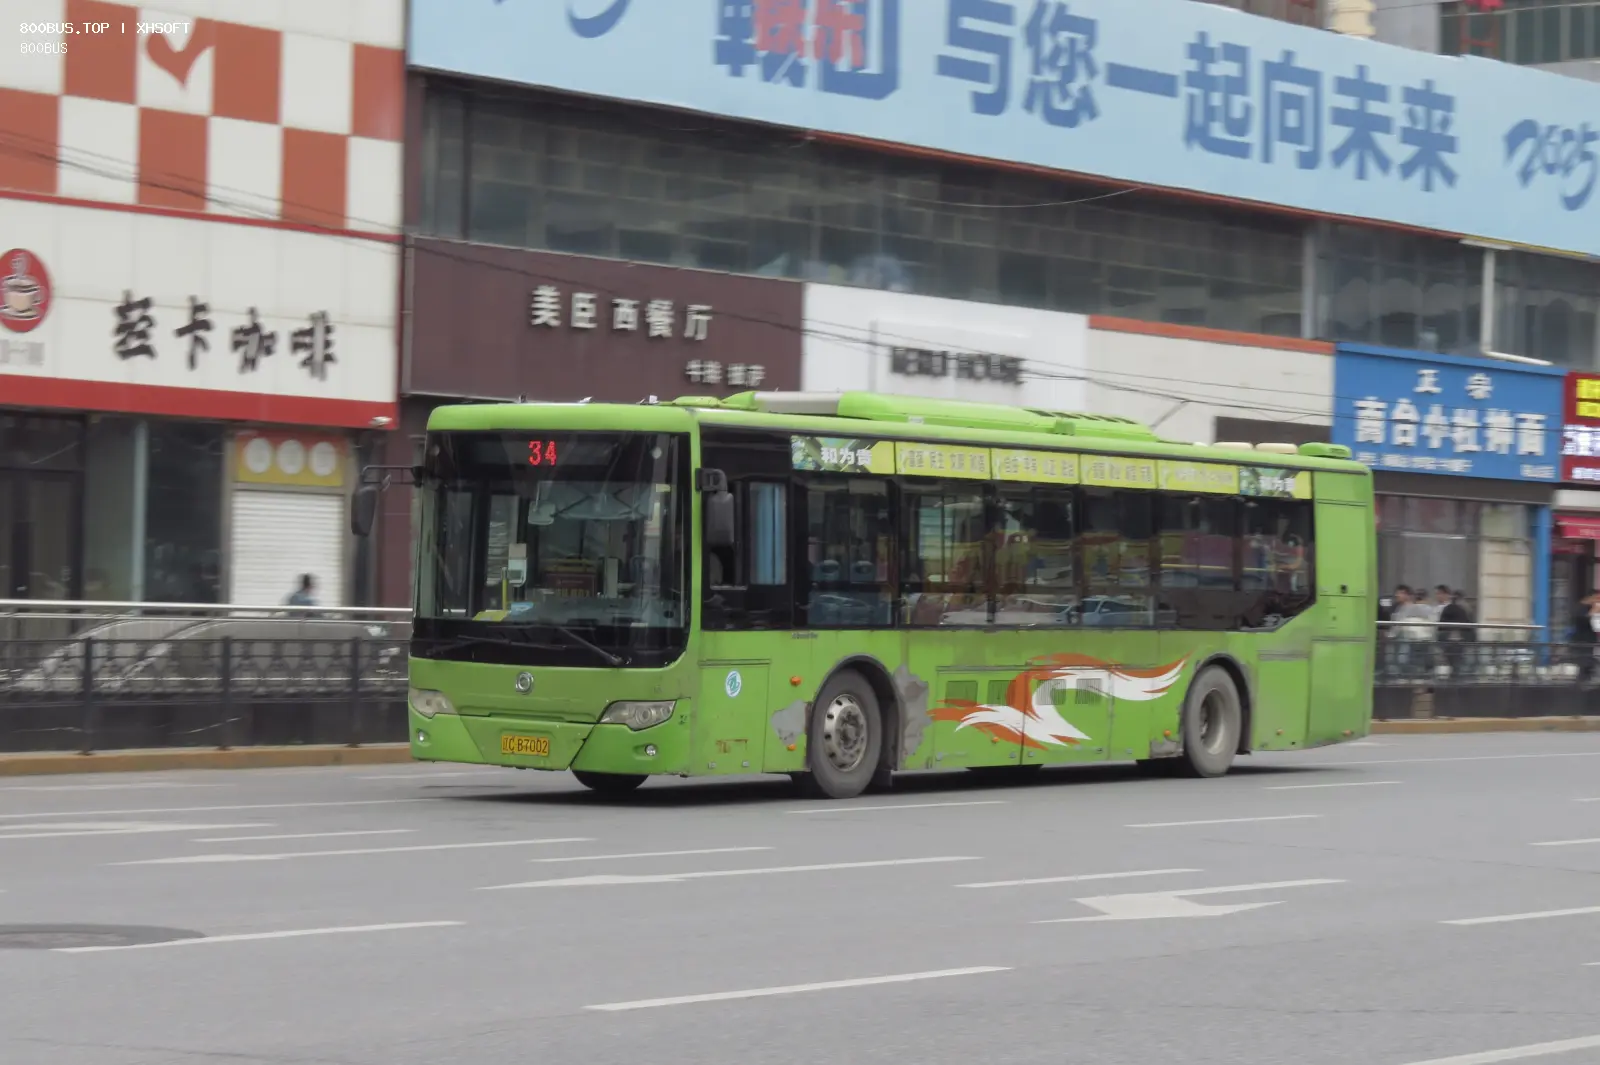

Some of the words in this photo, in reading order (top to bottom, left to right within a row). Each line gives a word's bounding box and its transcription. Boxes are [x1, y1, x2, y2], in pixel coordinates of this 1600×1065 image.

[935, 0, 1459, 193] 与您一起向未来
[531, 284, 713, 341] 美臣西餐厅
[528, 440, 557, 466] 34
